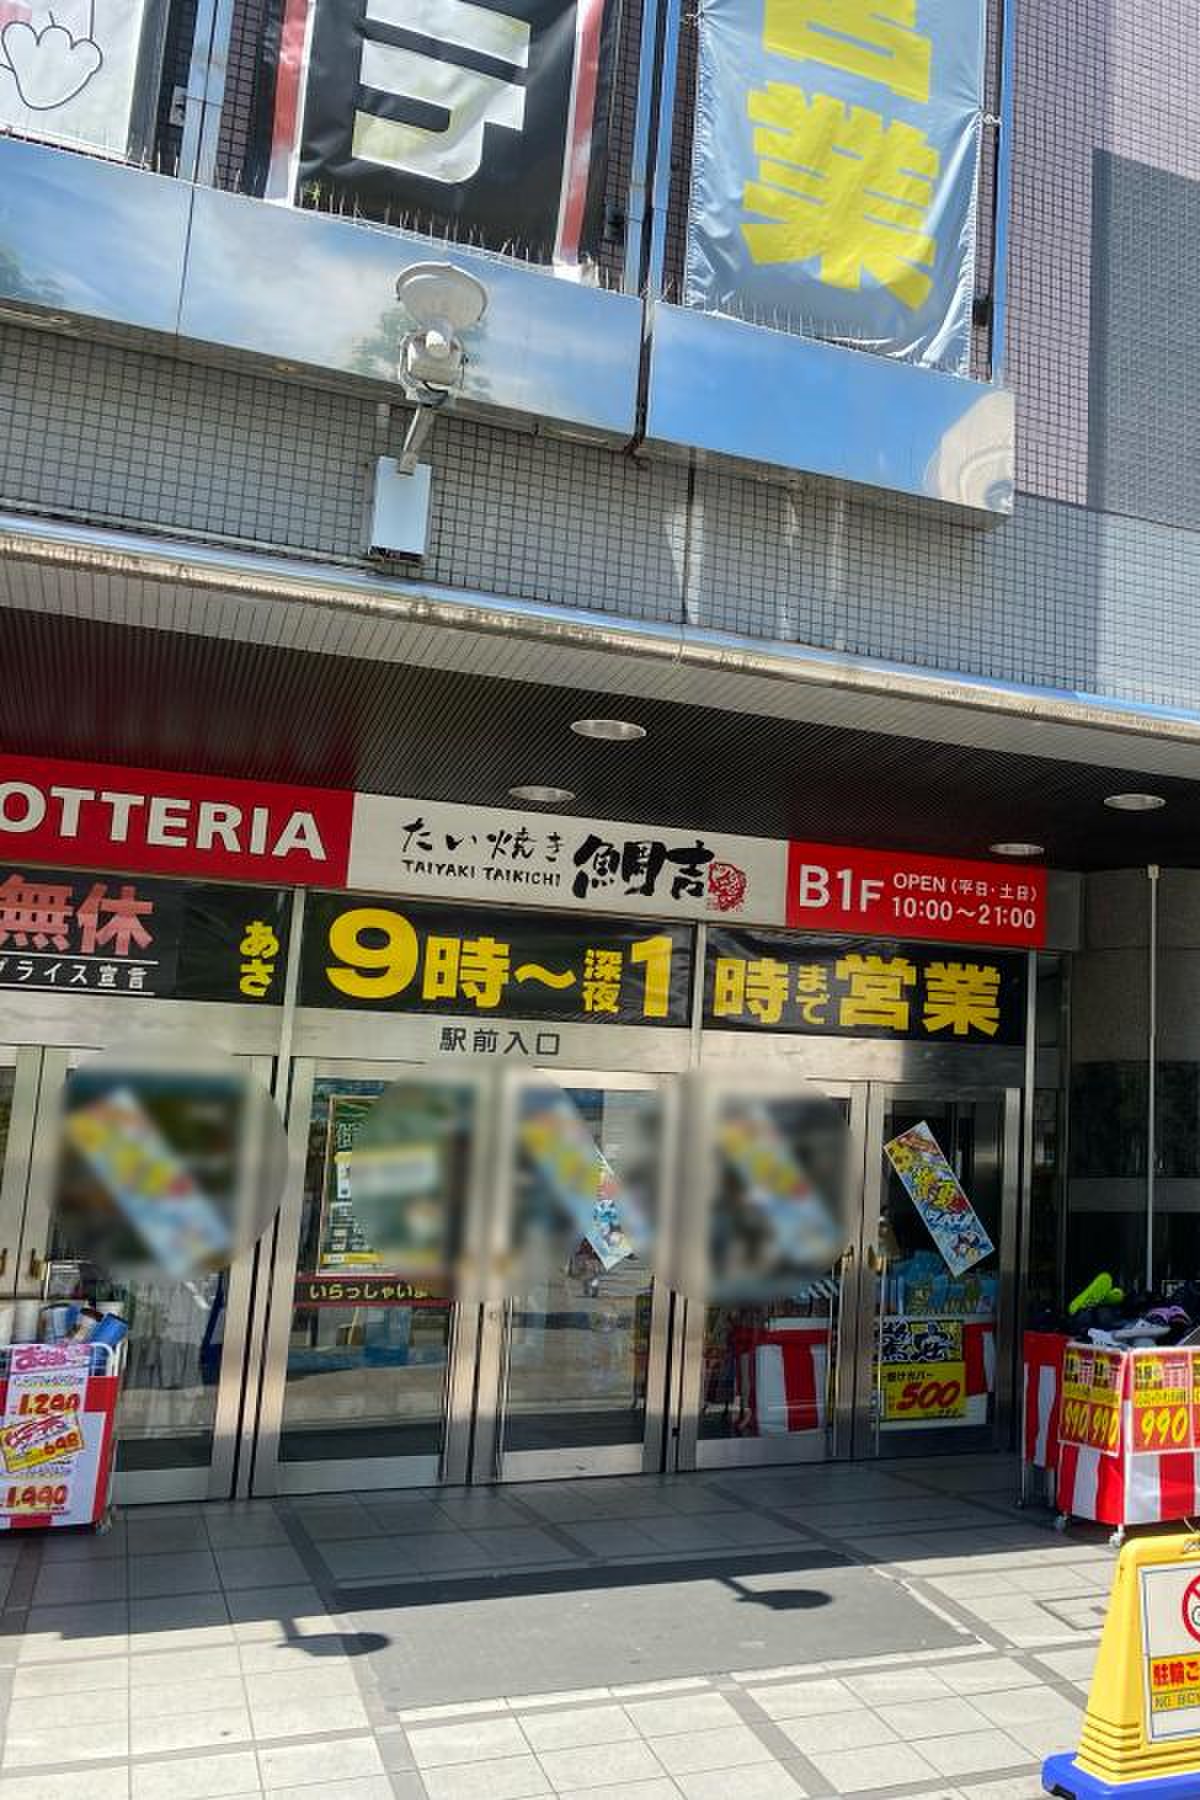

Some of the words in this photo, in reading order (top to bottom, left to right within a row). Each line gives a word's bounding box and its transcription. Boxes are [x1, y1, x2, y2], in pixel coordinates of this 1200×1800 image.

[0, 781, 327, 861] OTTERIA
[401, 817, 564, 863] たい焼き
[402, 859, 475, 880] TAIYAKI
[483, 866, 562, 888] TAIKICHI
[572, 833, 715, 899] 鯛吉
[799, 864, 885, 912] B1F
[893, 872, 946, 894] OPEN
[0, 875, 154, 956] 無休
[239, 920, 280, 998] あさ
[439, 1027, 561, 1056] 駅前入口
[896, 1381, 961, 1411] 500
[1141, 1405, 1190, 1445] 990
